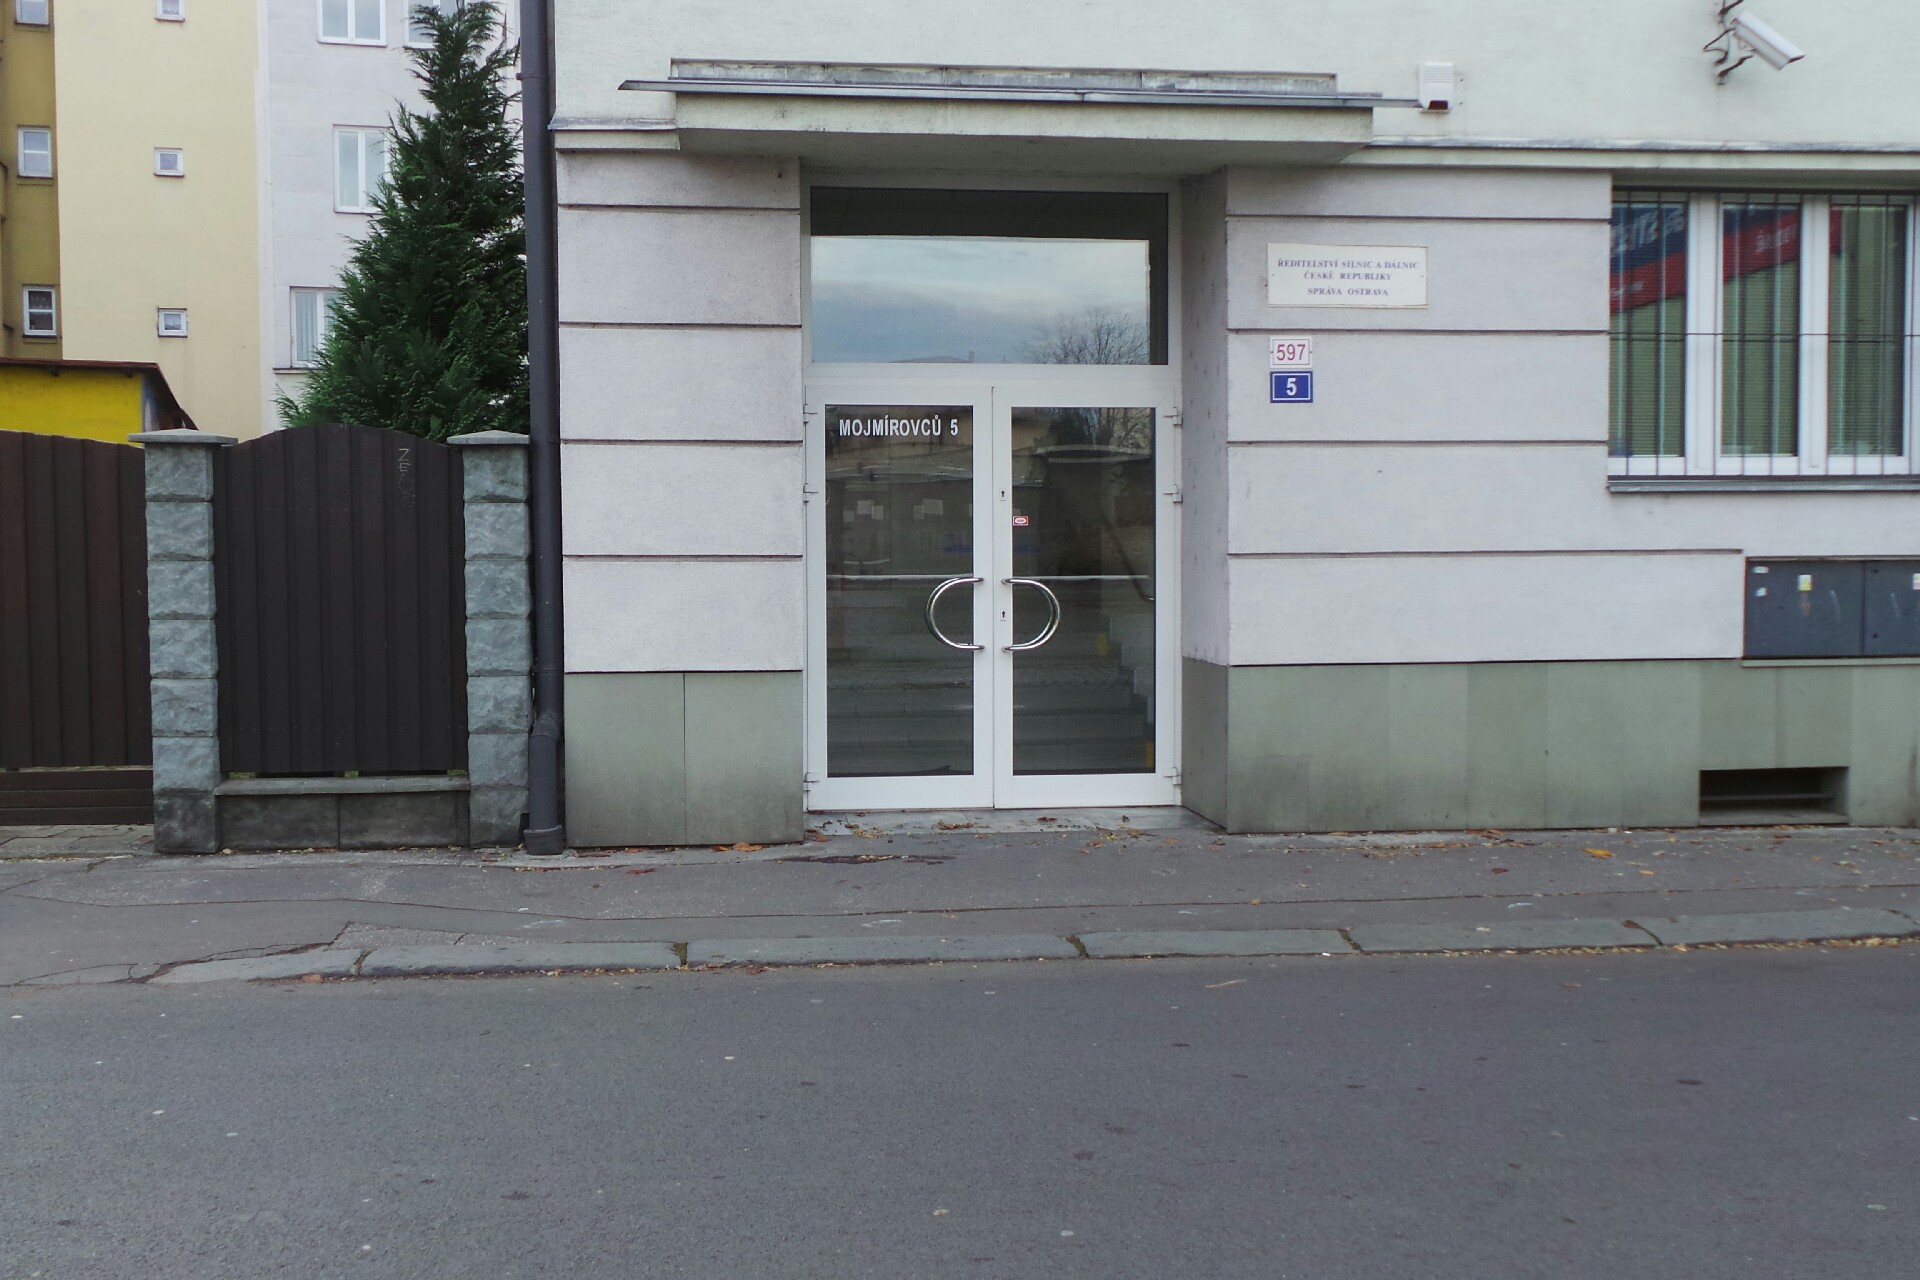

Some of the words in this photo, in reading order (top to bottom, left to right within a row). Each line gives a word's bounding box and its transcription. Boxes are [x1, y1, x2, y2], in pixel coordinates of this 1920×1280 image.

[1342, 259, 1373, 269] SILNIC
[1375, 261, 1382, 269] A
[1384, 259, 1420, 269] DÁLNIC
[1304, 270, 1334, 280] ČESKÉ
[1340, 272, 1392, 281] REPUBLIKY
[1308, 285, 1342, 296] SPRÁVA
[1347, 288, 1389, 297] OSTRAVA
[1276, 343, 1307, 361] 597
[1286, 377, 1298, 396] 5
[839, 414, 942, 437] MOJMÍROVCŮ
[950, 418, 959, 436] 5
